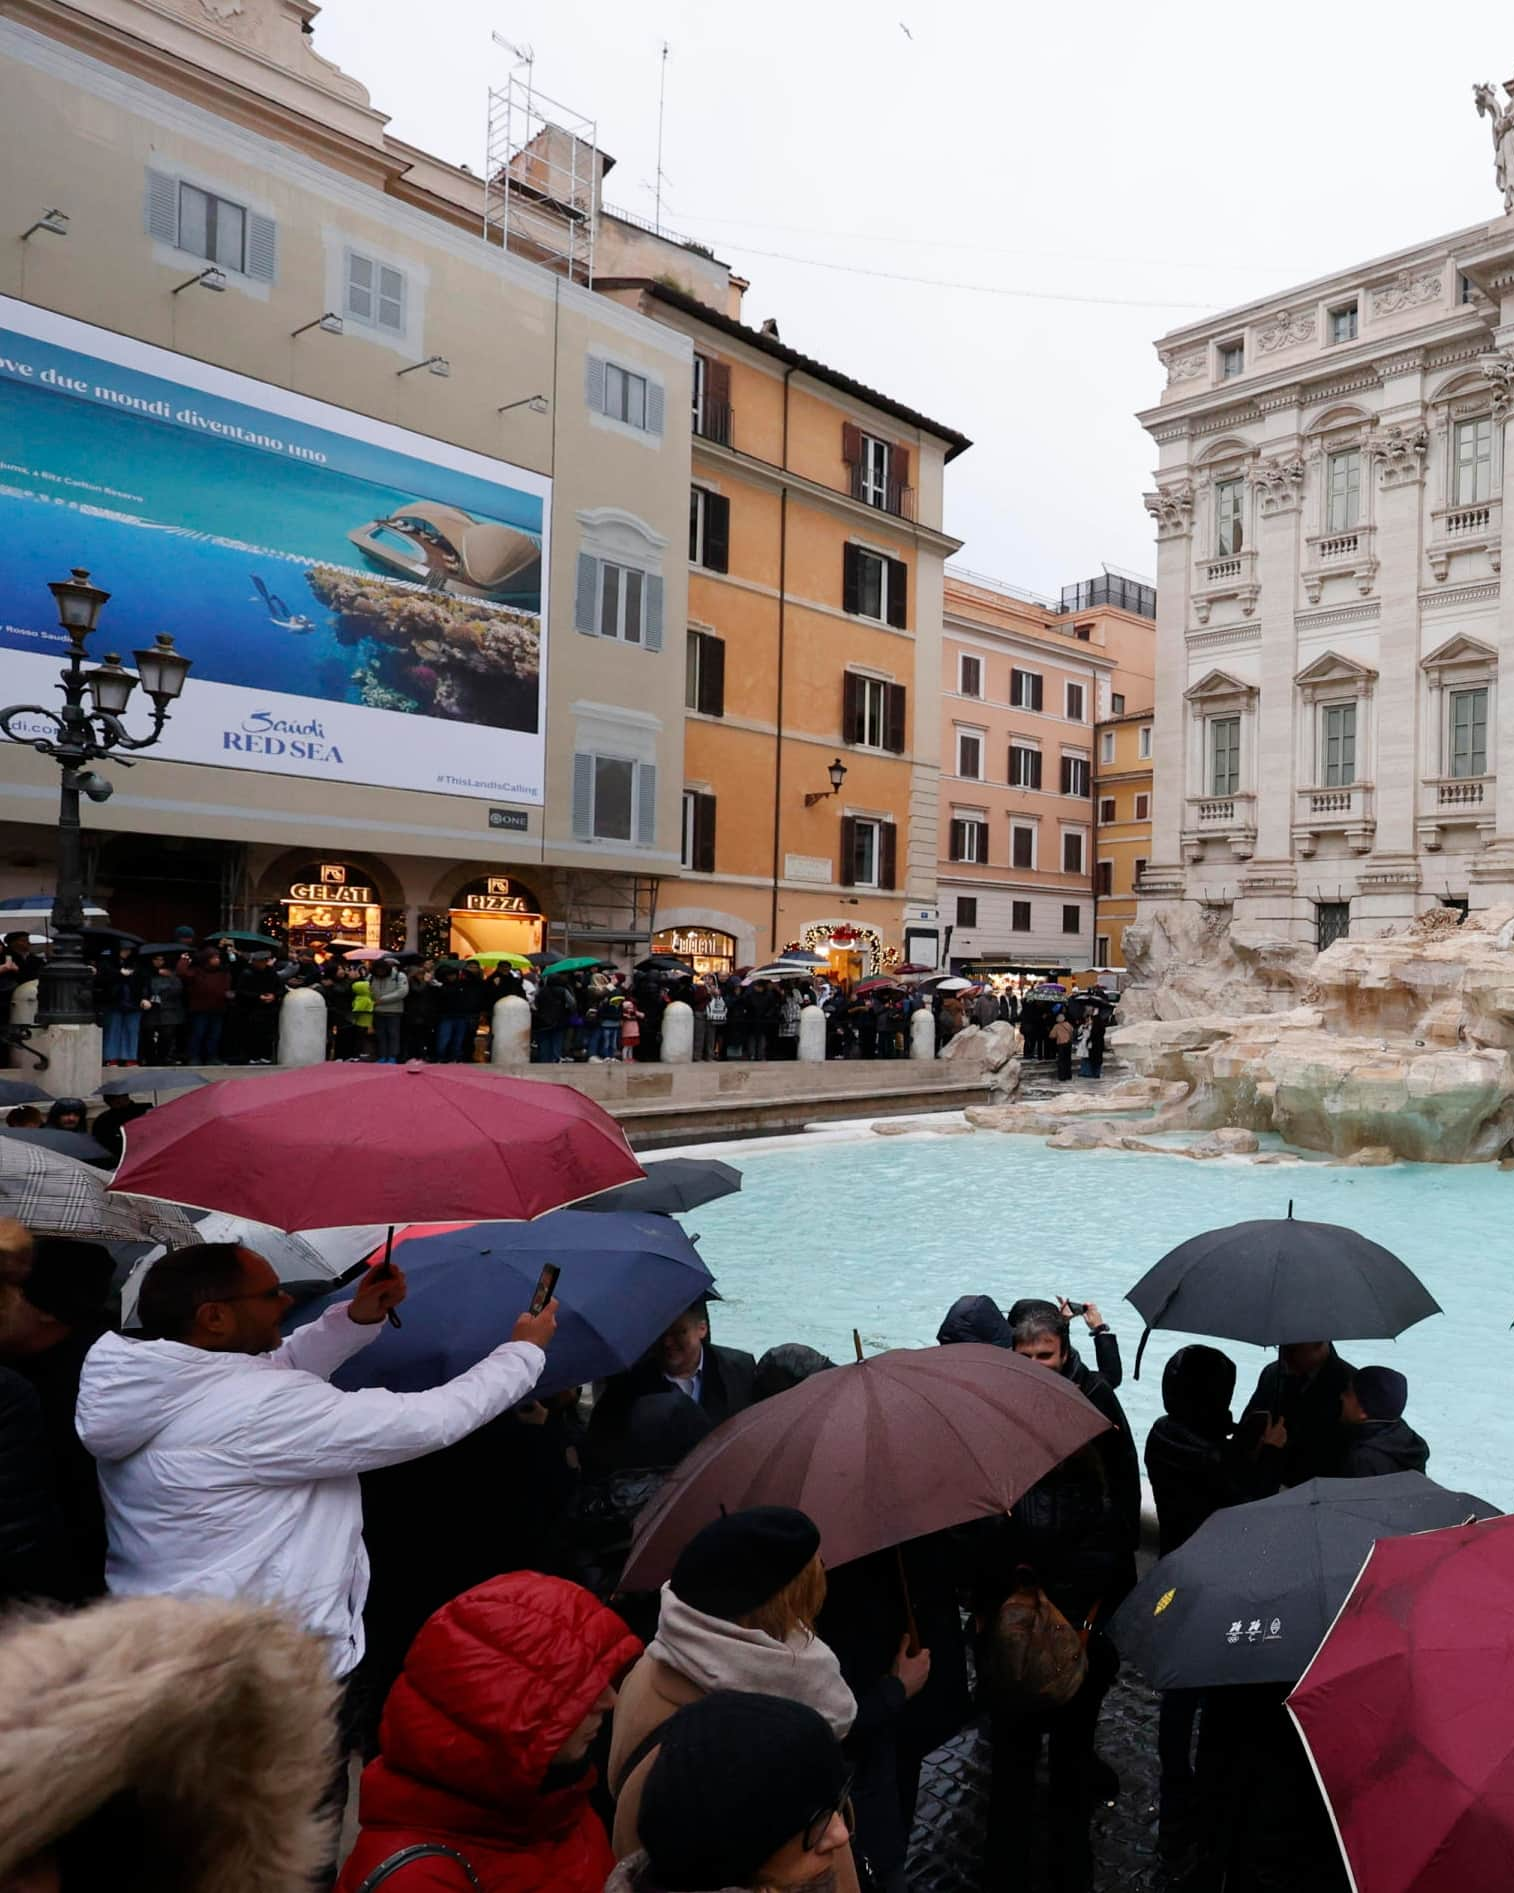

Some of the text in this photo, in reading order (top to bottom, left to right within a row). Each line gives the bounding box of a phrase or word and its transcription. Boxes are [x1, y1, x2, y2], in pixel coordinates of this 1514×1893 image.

[40, 369, 88, 393] due
[95, 386, 170, 418] mondi
[176, 409, 283, 451] diventano
[288, 444, 327, 464] uno
[6, 624, 38, 637] Rosso
[223, 731, 344, 764] RED SEA
[437, 775, 539, 797] #ThisLandIsCalling
[289, 882, 371, 903] GELATI
[467, 894, 528, 912] PIZZA
